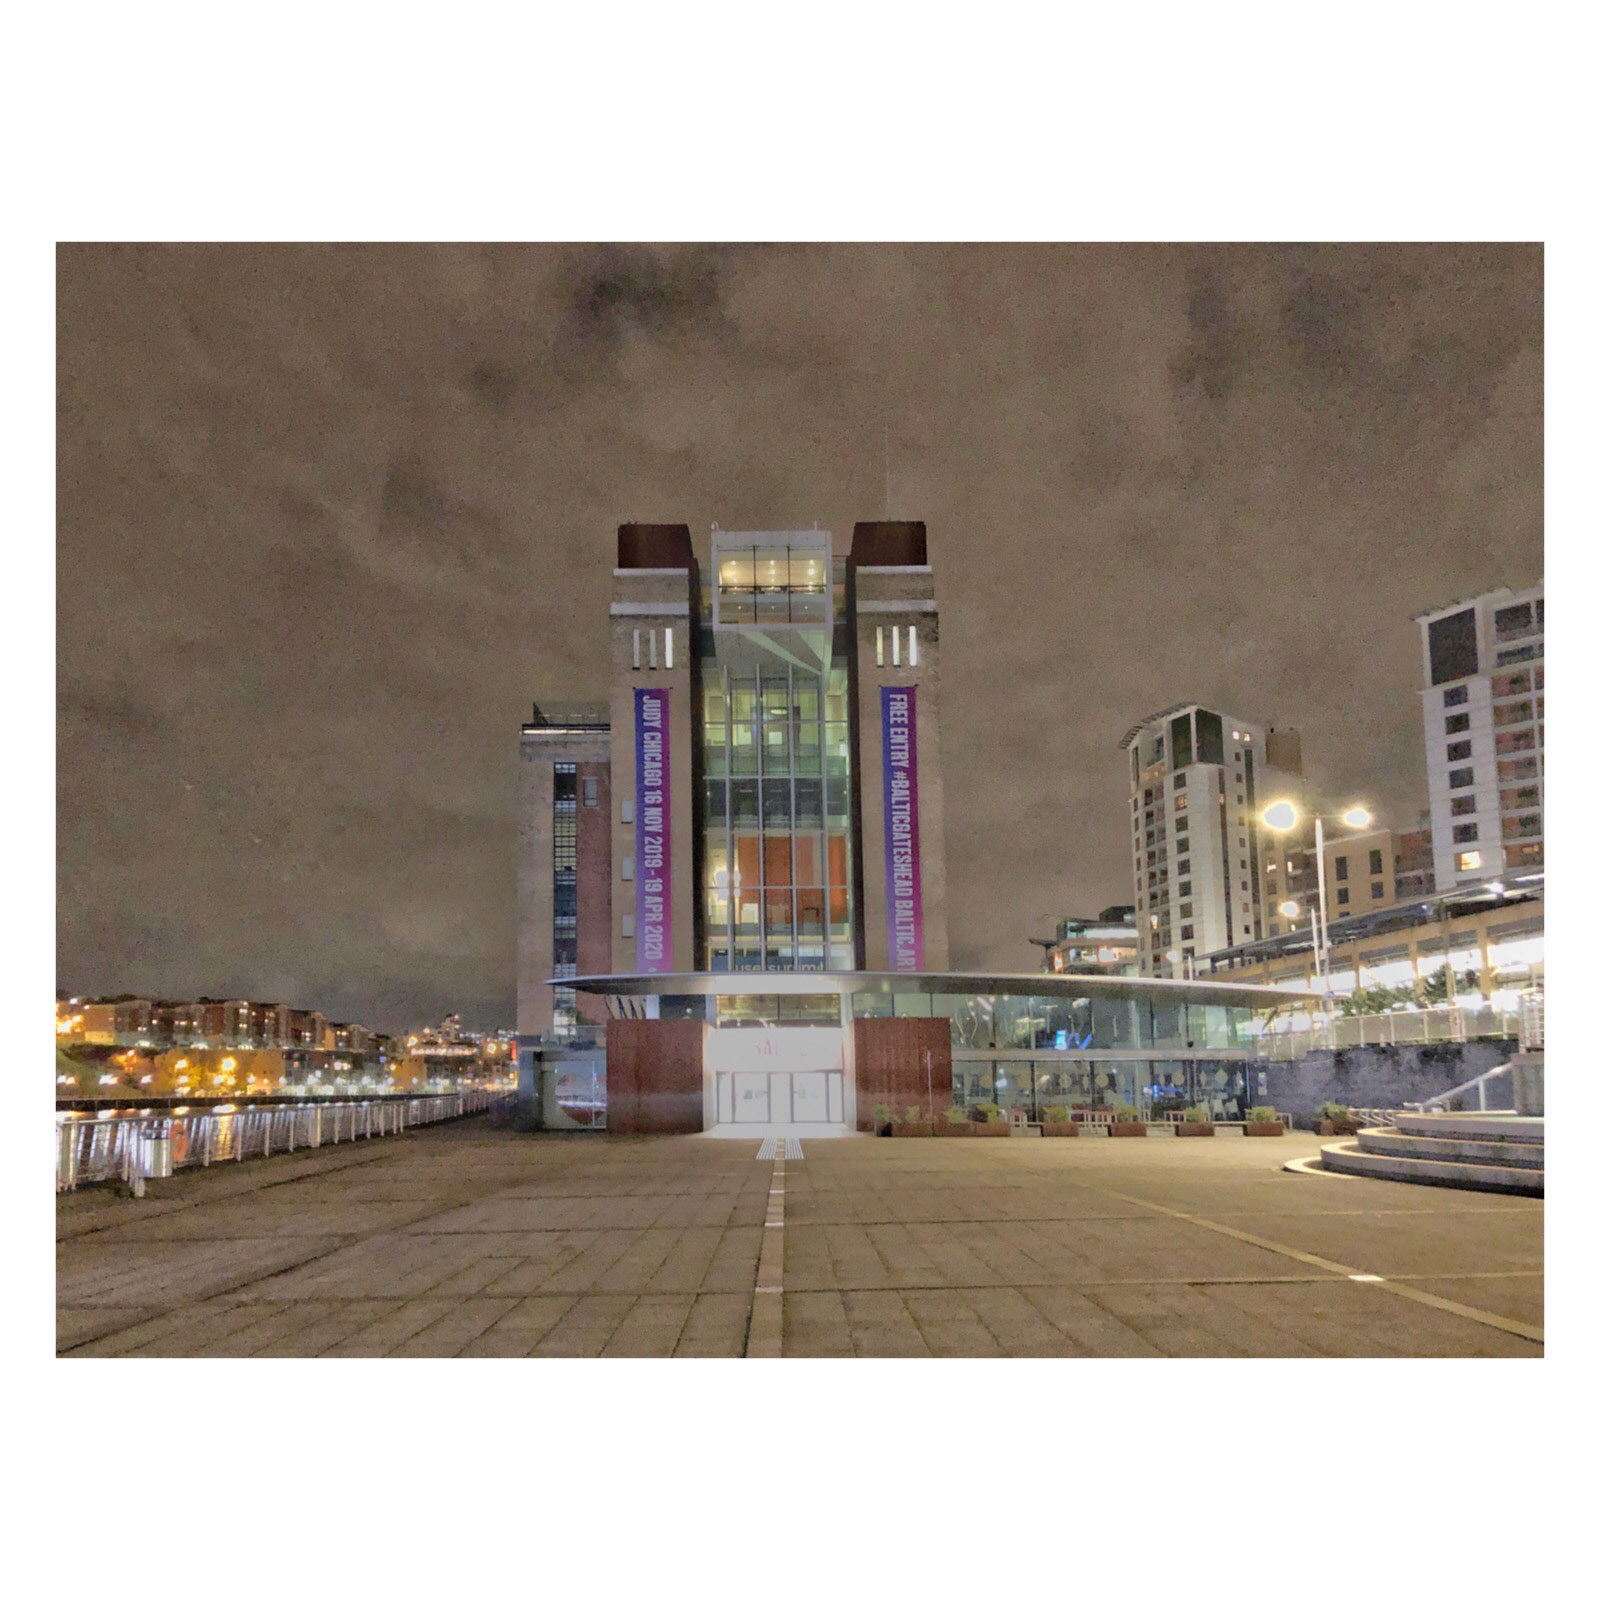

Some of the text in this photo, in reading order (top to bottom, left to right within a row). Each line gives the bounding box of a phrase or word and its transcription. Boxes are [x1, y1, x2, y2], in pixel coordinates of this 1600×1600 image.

[643, 695, 661, 728] JUDY
[889, 694, 908, 724] FREE
[643, 732, 662, 787] CHICAGO
[890, 727, 909, 768] ENTRY
[644, 790, 663, 804] 16
[644, 807, 663, 833] NOV
[891, 771, 913, 896] #BALTICGATESHEAD
[644, 836, 663, 868] 2019
[644, 878, 663, 893] 19
[644, 896, 663, 922] APR
[644, 925, 663, 960] 2020
